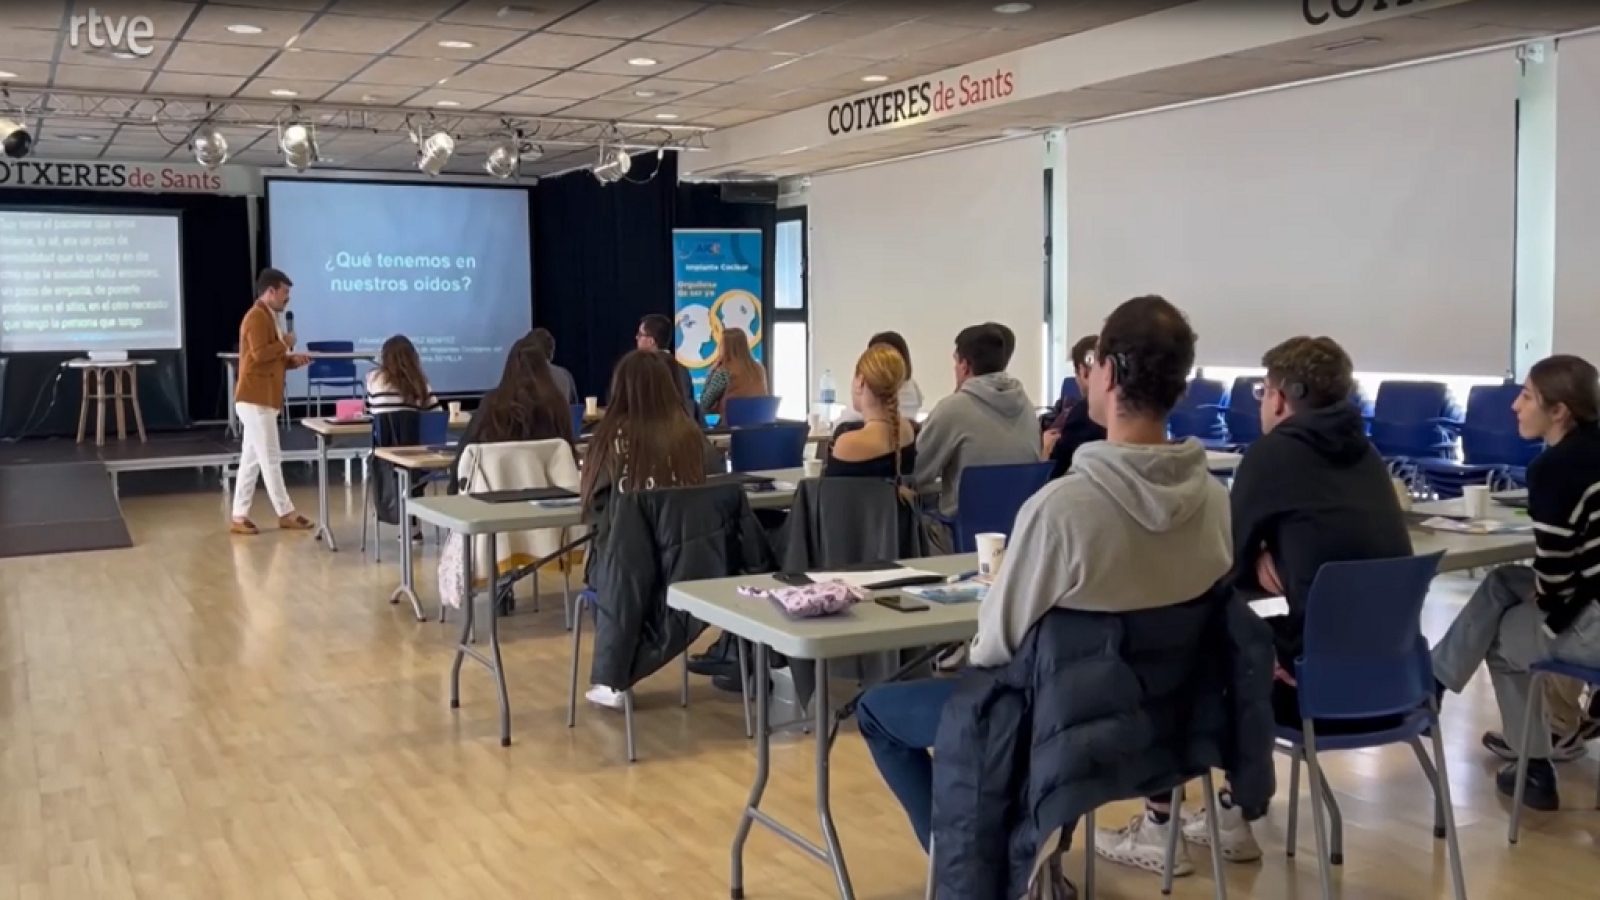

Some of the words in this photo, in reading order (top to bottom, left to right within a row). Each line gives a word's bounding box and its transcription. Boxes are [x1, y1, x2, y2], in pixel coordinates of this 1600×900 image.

[828, 81, 931, 136] COTXERES
[933, 80, 956, 112] de
[959, 68, 1013, 107] Sants
[128, 167, 155, 188] de
[160, 168, 222, 190] Sants
[324, 251, 373, 271] ¿Qué
[377, 252, 451, 269] tenemos
[455, 255, 476, 269] en
[331, 275, 408, 291] nuestros
